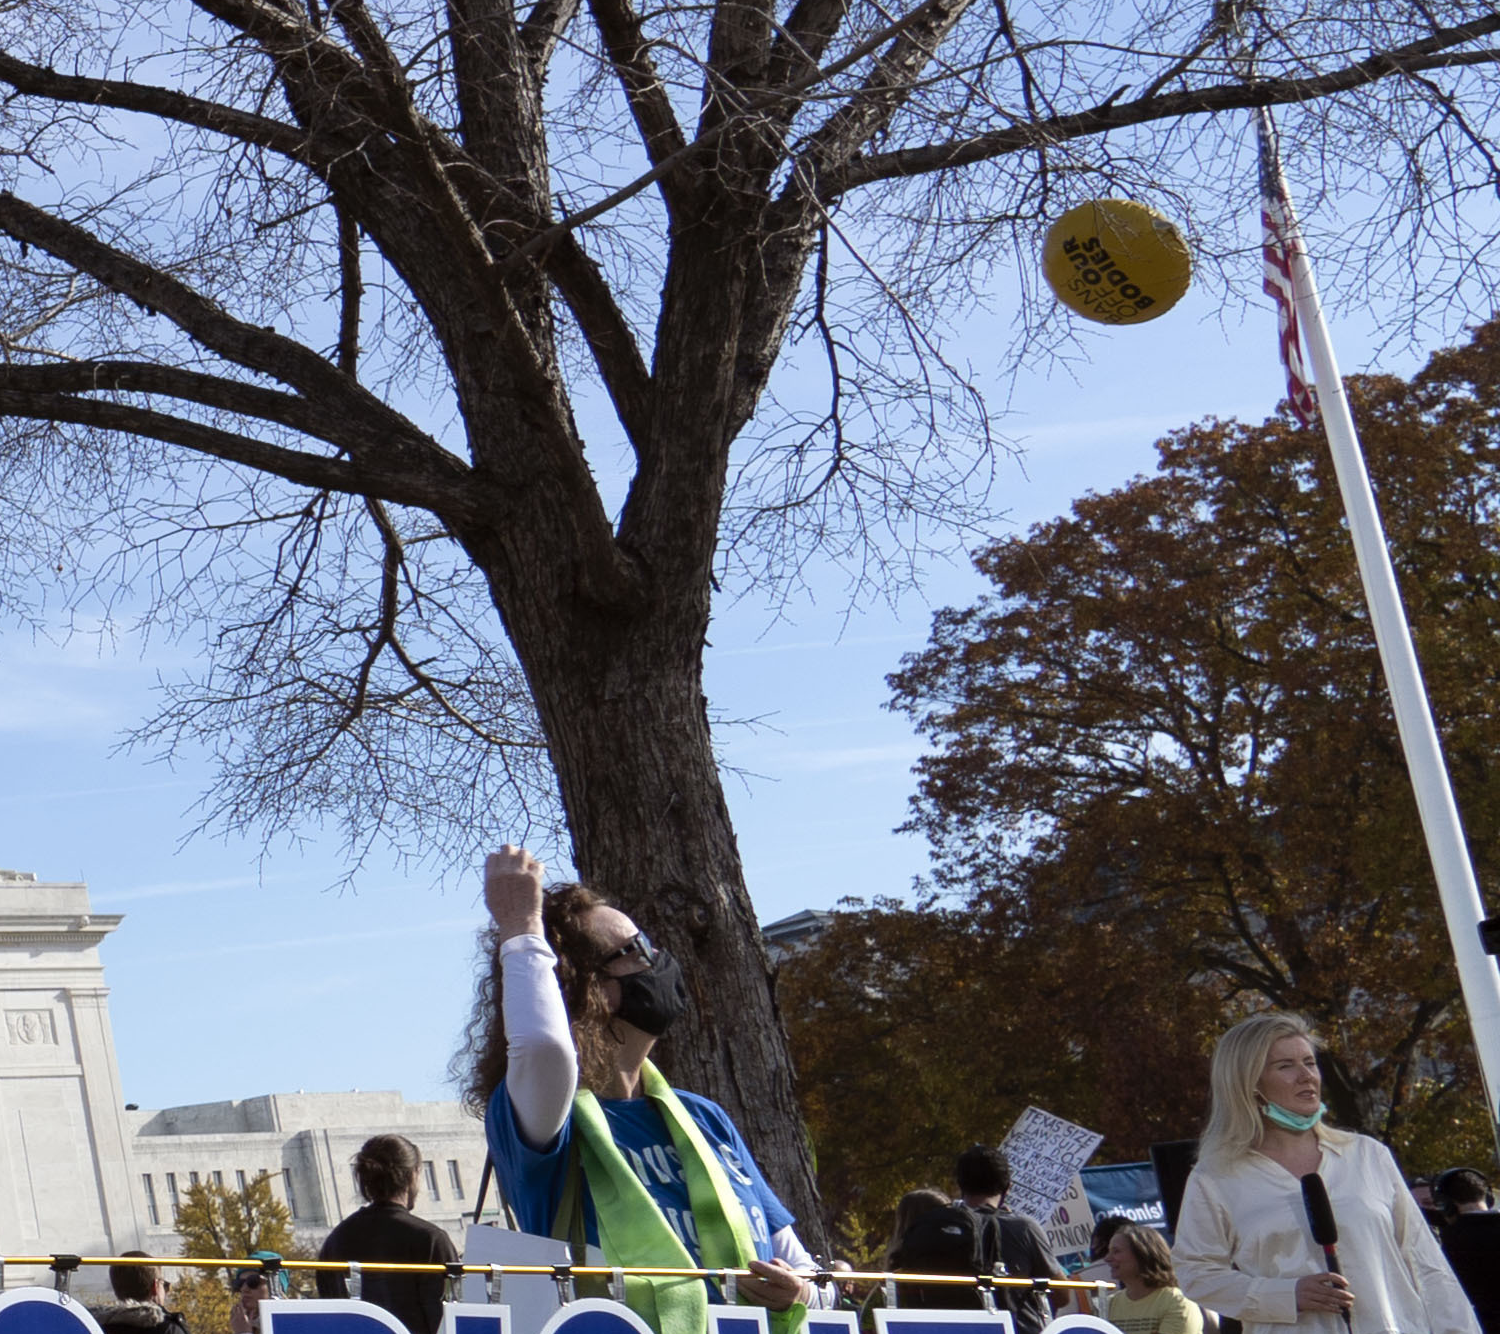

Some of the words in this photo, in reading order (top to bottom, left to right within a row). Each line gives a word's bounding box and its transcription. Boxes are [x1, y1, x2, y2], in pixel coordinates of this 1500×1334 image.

[1062, 236, 1101, 286] OUR
[1082, 236, 1156, 310] BODIES
[1068, 278, 1124, 323] BANS
[1095, 284, 1139, 319] OFF
[1011, 1129, 1047, 1152] VERSUS
[1024, 1124, 1087, 1155] LAWSUIT
[1025, 1108, 1063, 1133] TEXAS
[1063, 1126, 1097, 1147] SIZE
[1051, 1206, 1070, 1227] NO
[1046, 1223, 1093, 1248] PINION
